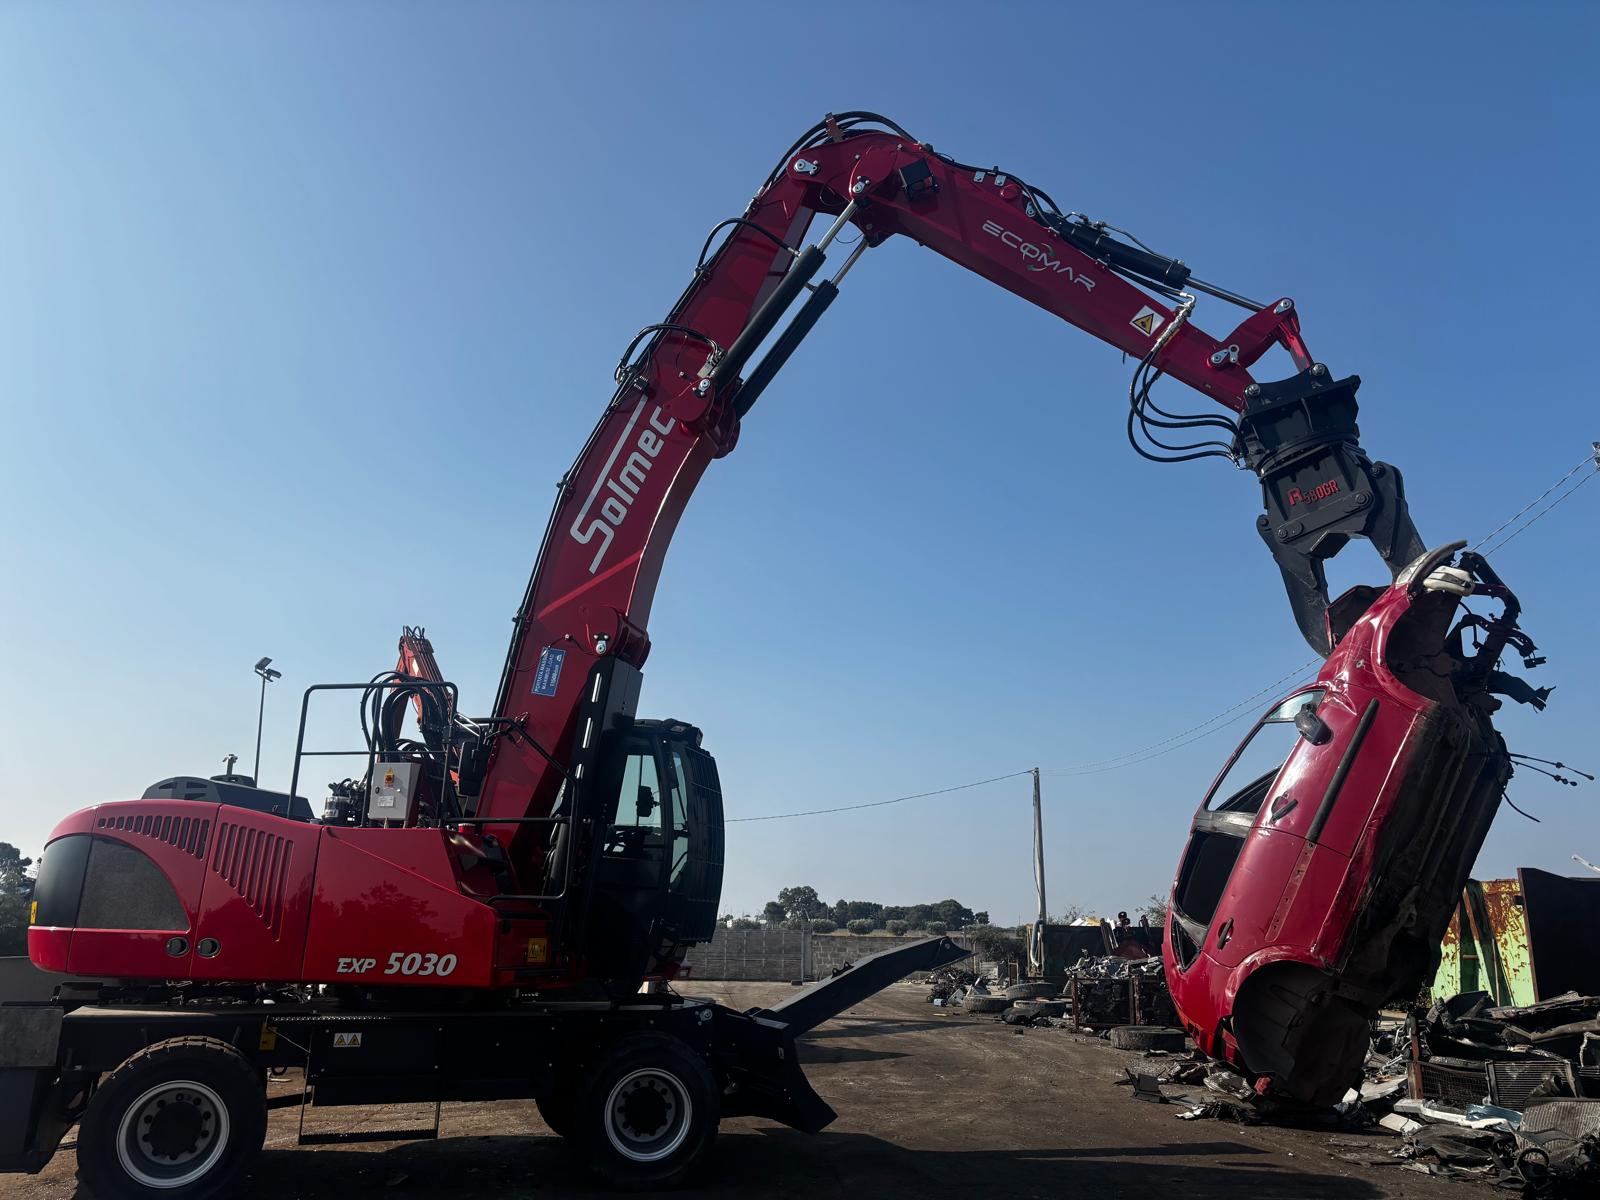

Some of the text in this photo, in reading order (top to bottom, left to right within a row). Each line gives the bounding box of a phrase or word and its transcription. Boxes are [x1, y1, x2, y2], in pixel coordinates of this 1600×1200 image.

[982, 219, 1096, 292] ECOMAR
[569, 395, 676, 575] Solmec
[336, 952, 458, 976] EXP 5030
